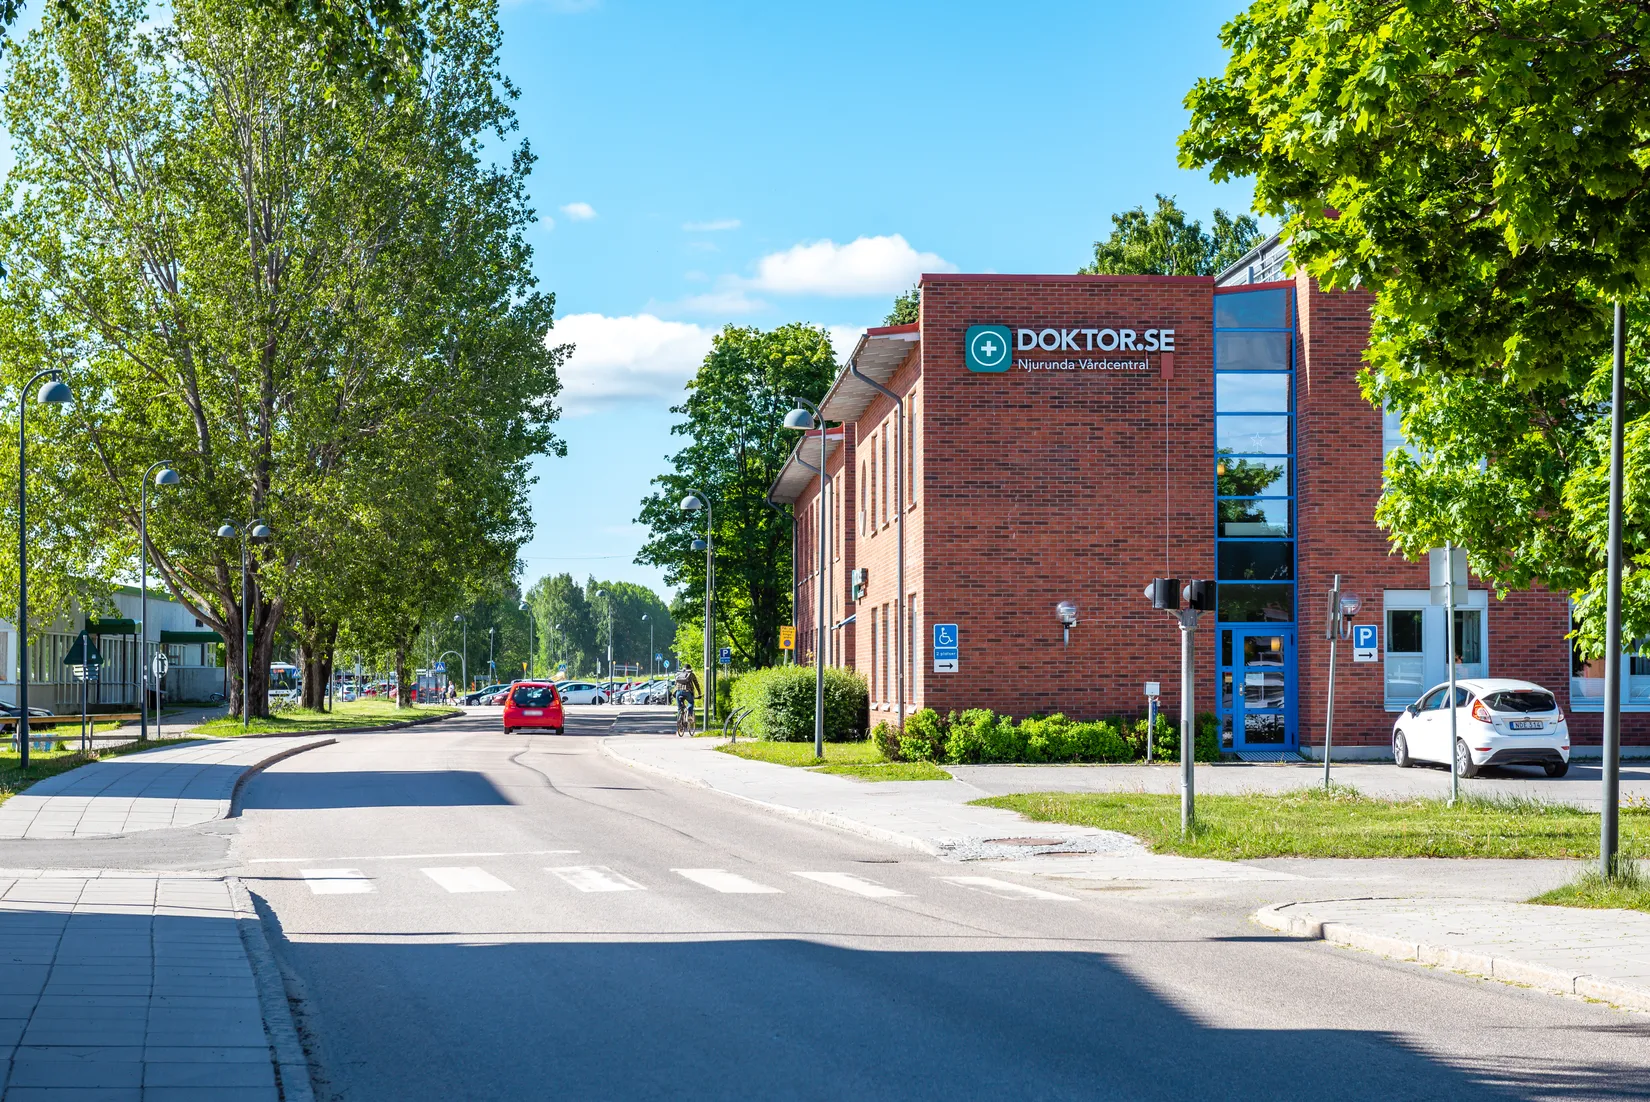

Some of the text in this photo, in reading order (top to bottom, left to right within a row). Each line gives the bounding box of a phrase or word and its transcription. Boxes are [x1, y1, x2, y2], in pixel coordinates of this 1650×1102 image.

[1017, 328, 1175, 351] DOKTOR.SE
[1018, 358, 1149, 372] Njurunda Vårdcentral
[1360, 628, 1372, 646] P
